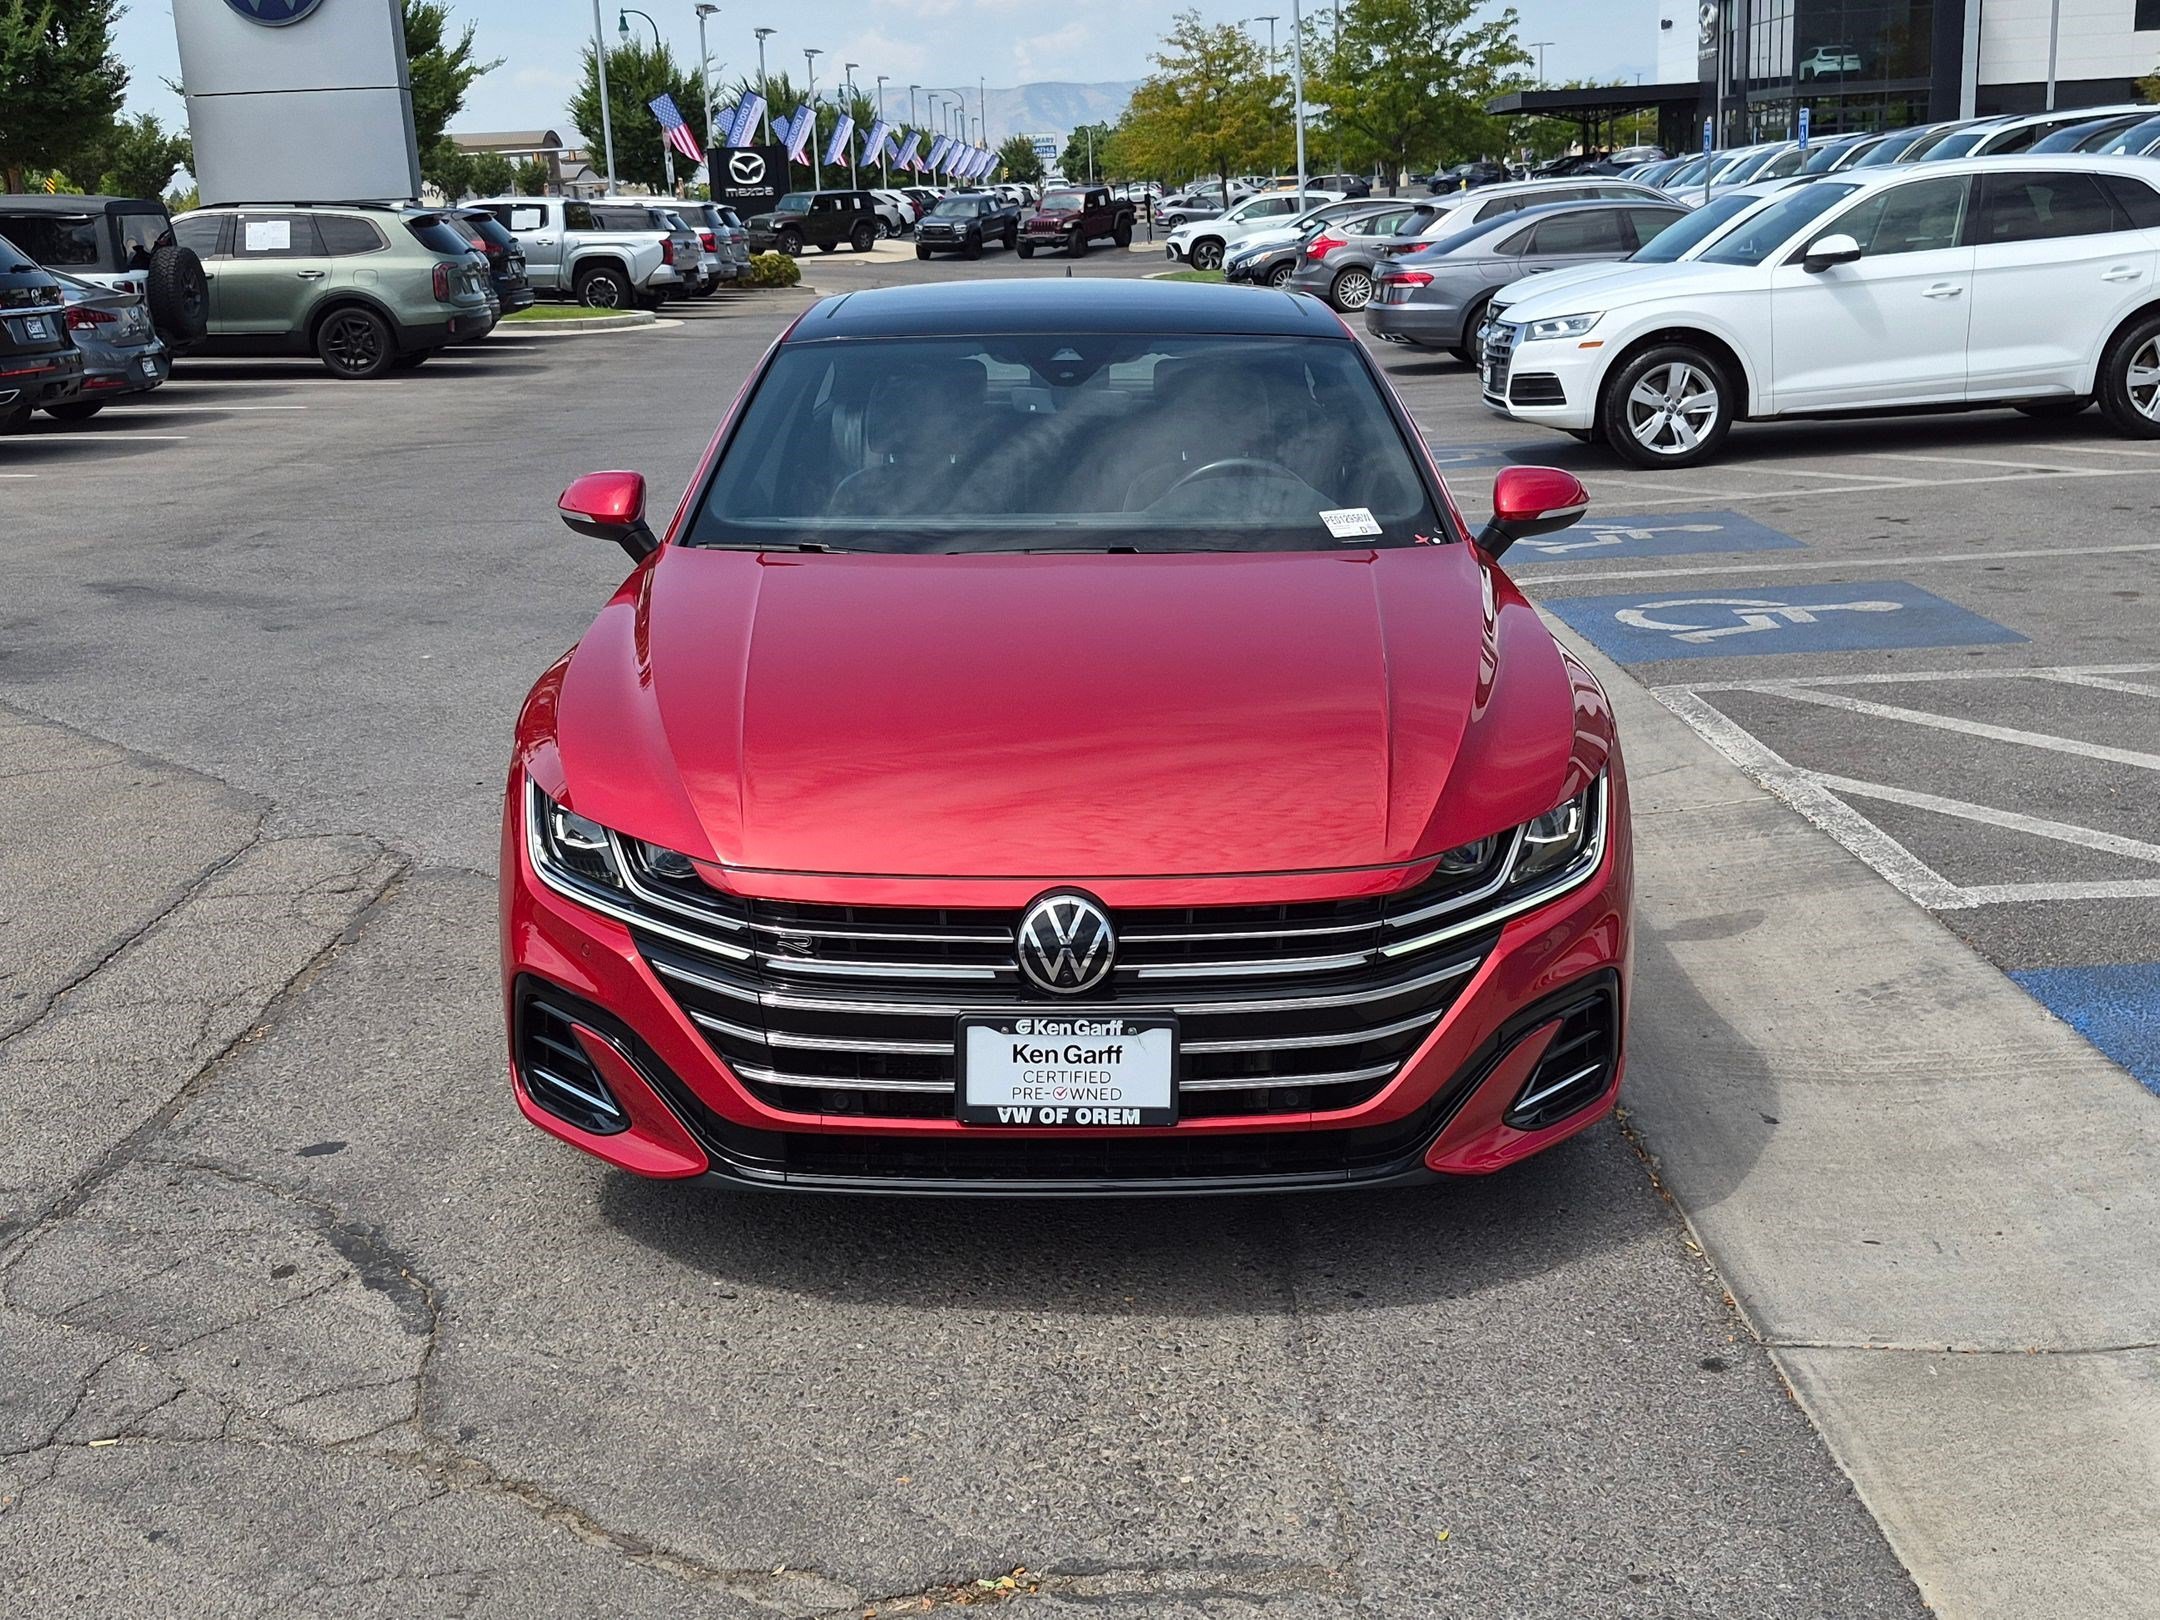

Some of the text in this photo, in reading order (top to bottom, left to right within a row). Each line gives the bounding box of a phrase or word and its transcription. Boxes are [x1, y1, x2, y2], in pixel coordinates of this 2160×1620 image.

[1034, 1019, 1072, 1036] Ken
[1074, 1019, 1124, 1036] Garff
[1012, 1043, 1123, 1065] Ken Garff
[1022, 1070, 1112, 1084] CERTIFIED
[997, 1107, 1141, 1125] VW OF OREM
